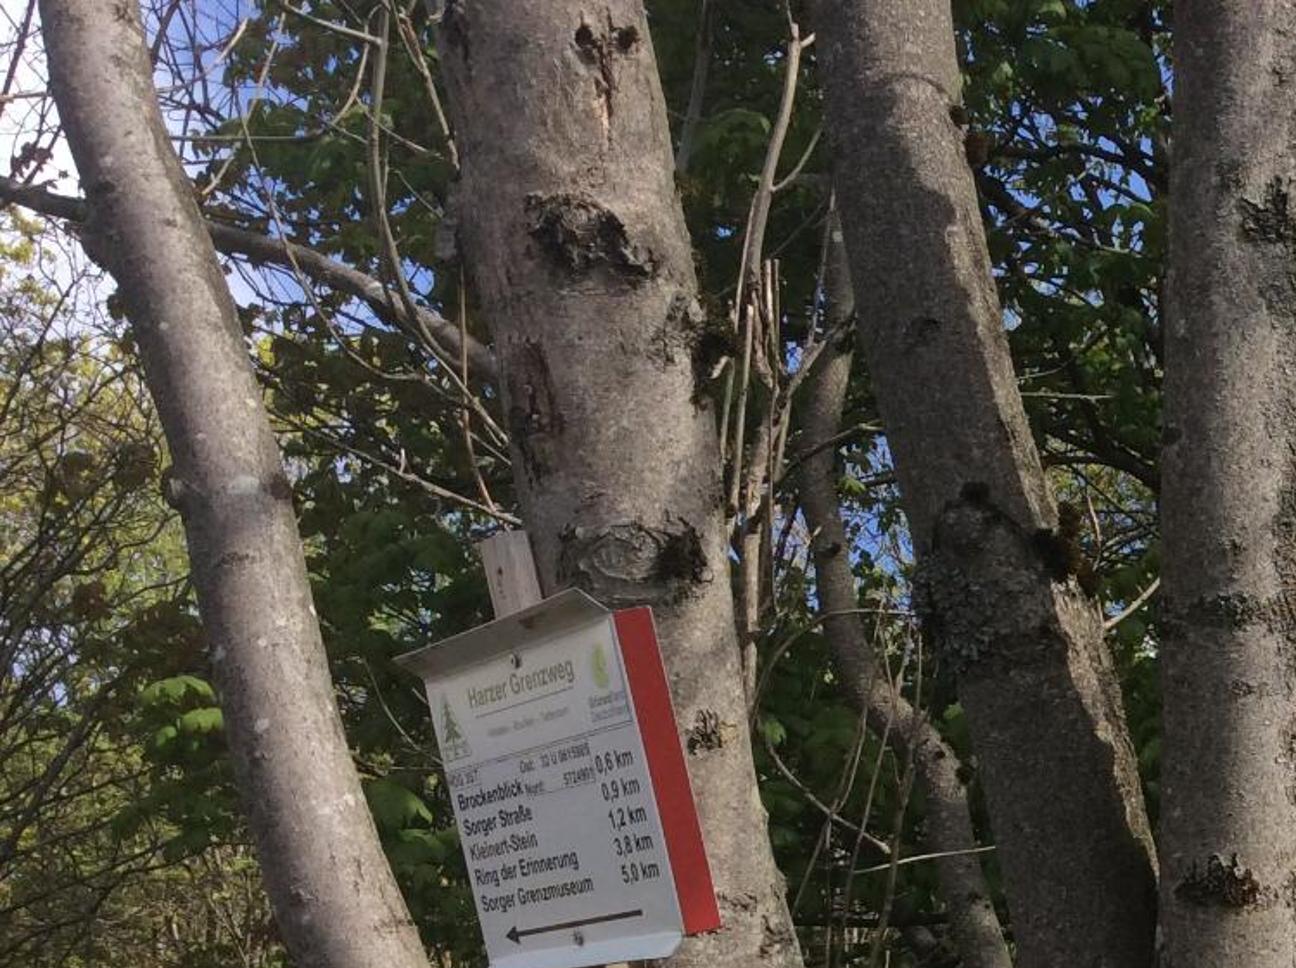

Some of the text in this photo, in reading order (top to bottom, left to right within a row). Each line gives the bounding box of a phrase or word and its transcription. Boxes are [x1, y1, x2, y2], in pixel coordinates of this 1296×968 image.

[468, 659, 575, 709] Harzer Grenzweg
[457, 750, 634, 812] Brockenblick 0,6 km
[463, 776, 640, 837] Sorger Straße 0,9 km
[469, 806, 647, 861] Kleinert-Stein 1,2 km
[474, 833, 654, 888] Ring der Erinnerung 3,8 km
[481, 861, 660, 914] Sorger Grenzmuseum 5,0 km
